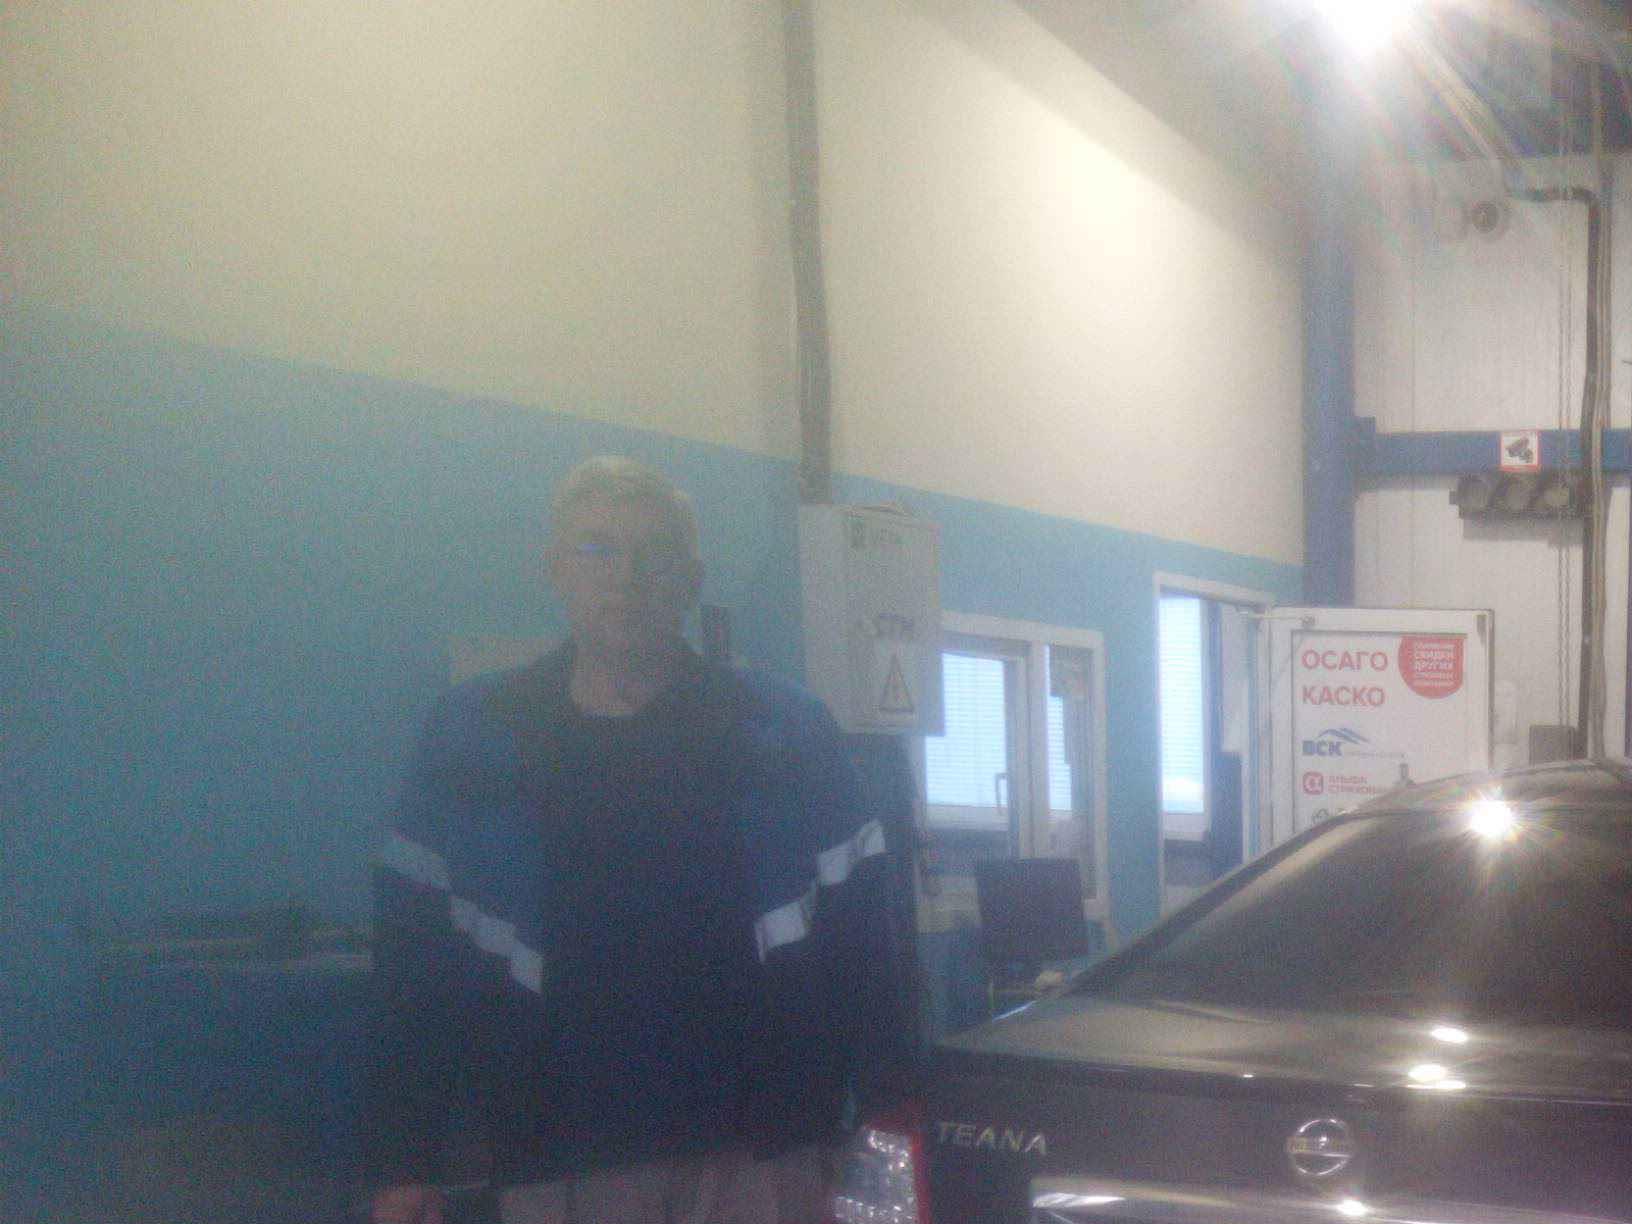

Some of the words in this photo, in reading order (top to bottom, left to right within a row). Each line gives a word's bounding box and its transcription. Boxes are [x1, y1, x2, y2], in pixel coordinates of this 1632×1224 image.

[1302, 650, 1389, 671] ОСАГО
[1302, 686, 1386, 707] КАСКО
[1302, 740, 1343, 756] ВСК
[936, 1121, 1048, 1156] TEANA
